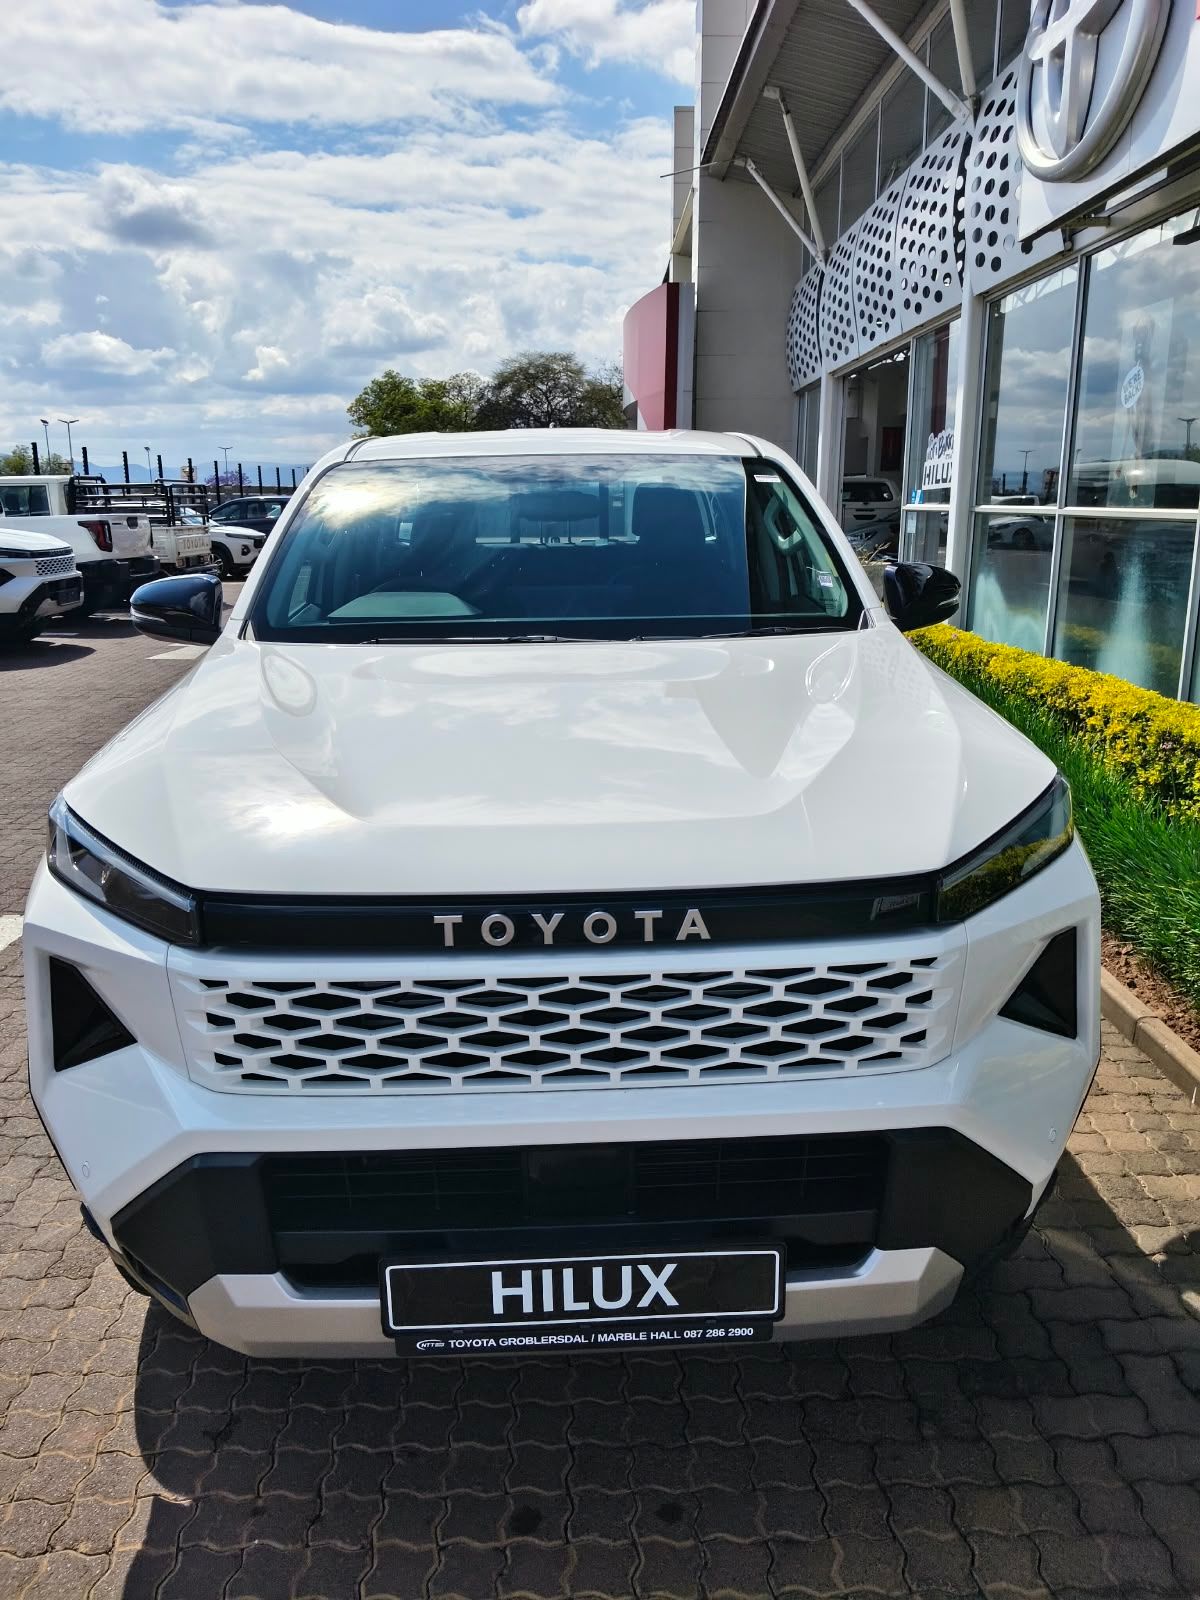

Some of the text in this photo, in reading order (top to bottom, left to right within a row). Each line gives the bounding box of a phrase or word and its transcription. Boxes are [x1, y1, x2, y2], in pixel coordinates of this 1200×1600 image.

[433, 908, 711, 947] TOYOTA
[491, 1263, 680, 1315] HILUX
[448, 1338, 497, 1348] TOYOTA
[499, 1334, 589, 1346] GROBLERSDAL
[597, 1331, 647, 1342] MARBLE
[650, 1330, 682, 1340] HALL
[683, 1329, 703, 1339] 087
[705, 1328, 725, 1338] 286
[727, 1327, 754, 1337] 2900
